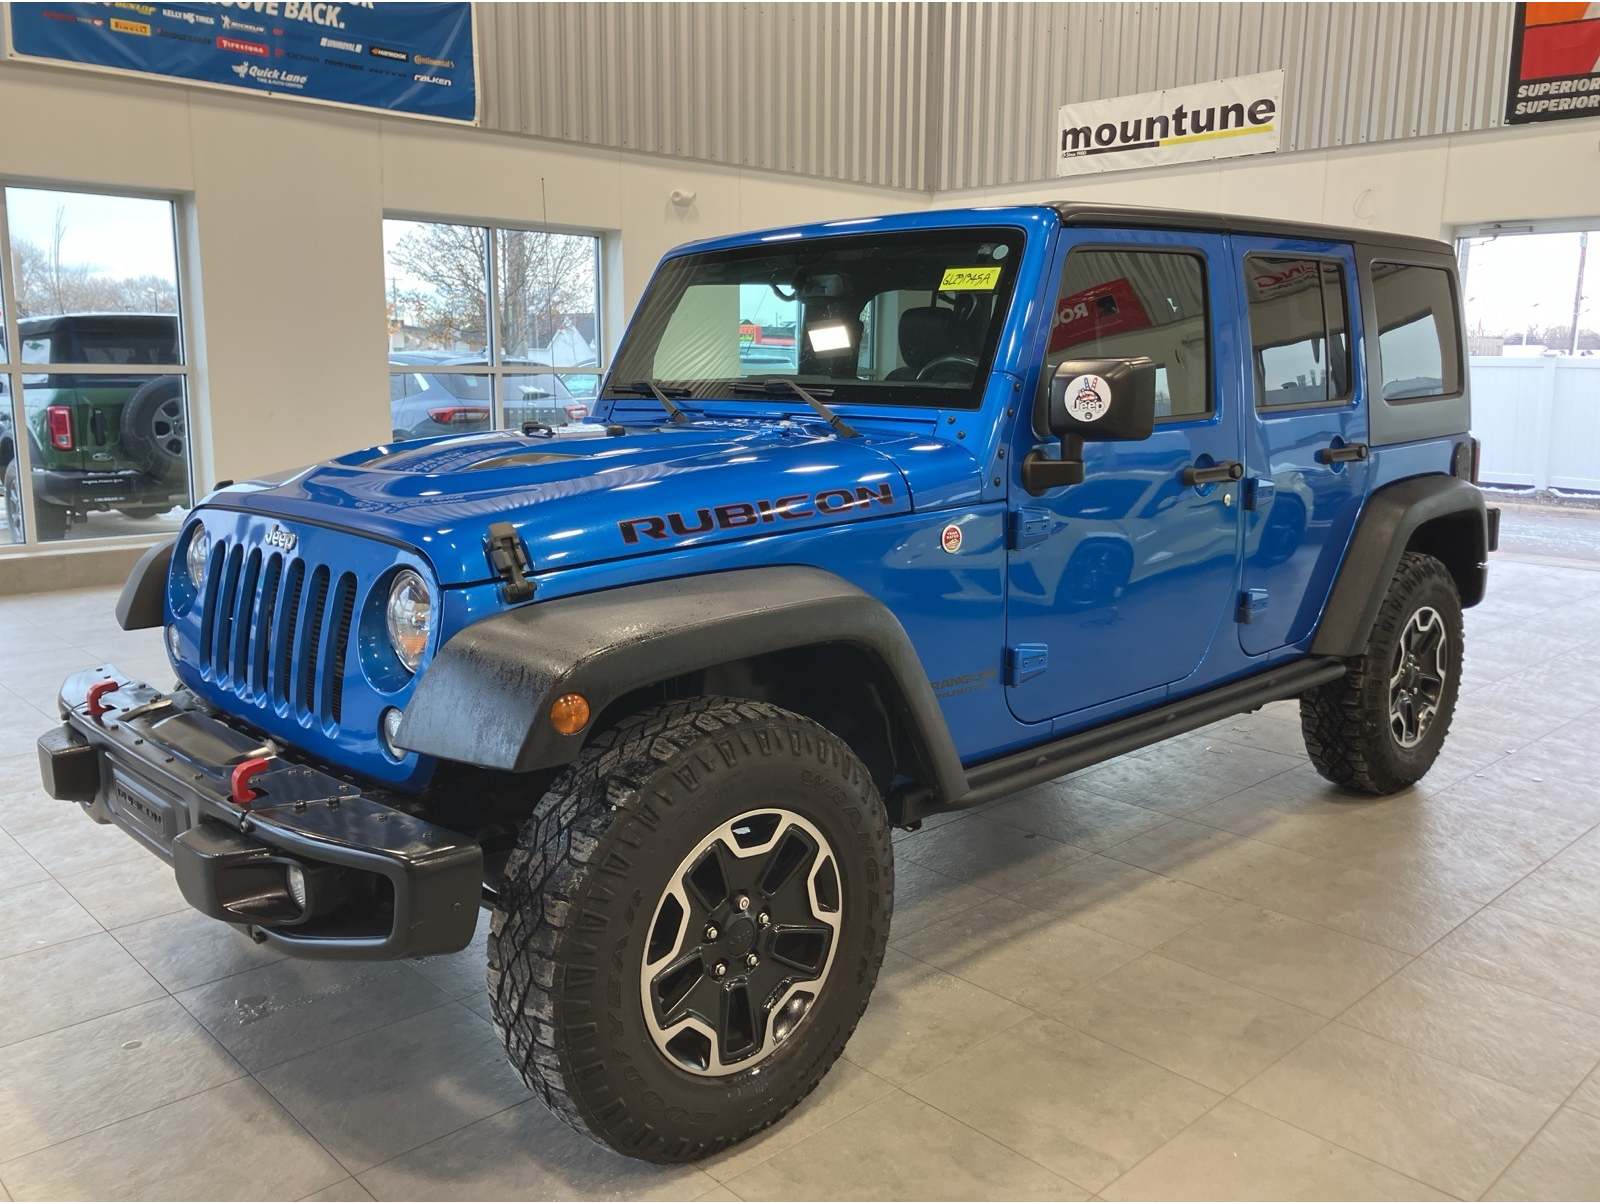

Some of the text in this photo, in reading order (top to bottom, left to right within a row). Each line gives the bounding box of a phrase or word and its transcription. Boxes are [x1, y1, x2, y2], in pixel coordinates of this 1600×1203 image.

[284, 2, 346, 29] BACK.
[249, 66, 280, 79] Quick
[1517, 77, 1600, 98] SUPERIOR
[1515, 94, 1600, 115] SUPERIOR
[1061, 98, 1276, 151] mountune
[618, 483, 896, 545] RUBICON
[265, 524, 298, 553] Jeep
